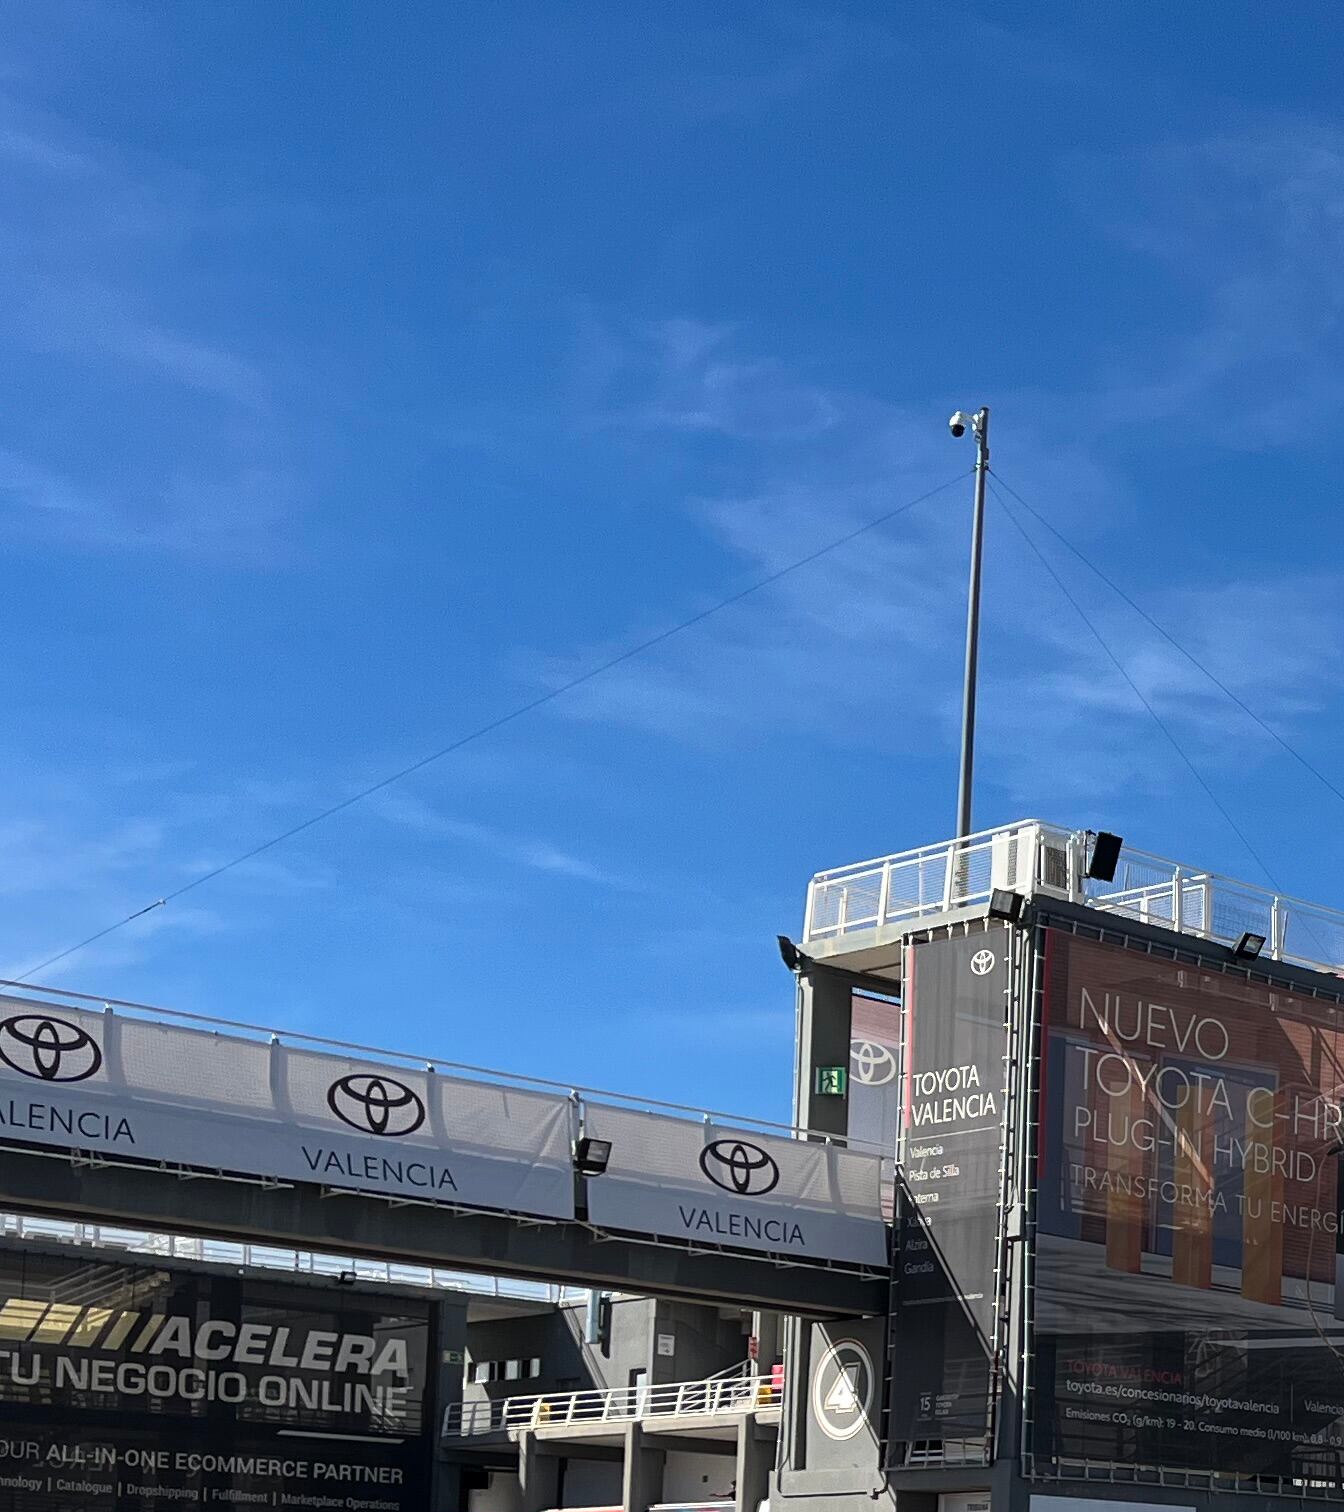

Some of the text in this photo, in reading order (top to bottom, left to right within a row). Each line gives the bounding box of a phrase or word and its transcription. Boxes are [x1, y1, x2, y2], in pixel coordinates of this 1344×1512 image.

[1080, 987, 1229, 1060] NUEVO
[912, 1064, 980, 1097] TOYOTA
[1075, 1046, 1344, 1145] TOYOTA C-HR
[911, 1092, 996, 1126] VALENCIA
[909, 1144, 943, 1159] Valencia
[1075, 1106, 1316, 1182] PLUG-IN HYBRID
[301, 1145, 458, 1191] VALENCIA
[909, 1168, 928, 1182] Pista
[930, 1167, 941, 1179] de
[1071, 1163, 1228, 1214] TRANSFORMA
[1235, 1194, 1262, 1219] TU
[678, 1205, 805, 1246] VALENCIA
[906, 1239, 928, 1251] Alzira
[149, 1315, 408, 1377] ACELERA
[55, 1356, 247, 1402] NEGOCIO
[258, 1375, 407, 1418] ONLINE
[1067, 1360, 1183, 1384] TOYOTA VALENCIA
[1066, 1379, 1280, 1415] toyota.es/concesionarios/toyotavalencia
[1304, 1400, 1344, 1415] Valencia
[1066, 1408, 1111, 1423] Emisiones
[1166, 1419, 1175, 1429] 19
[1198, 1422, 1238, 1436] Consumo
[46, 1443, 169, 1469] ALL-IN-ONE
[175, 1452, 308, 1478] ECOMMERCE
[313, 1463, 403, 1485] PARTNER
[56, 1479, 113, 1495] Catalogue
[126, 1483, 199, 1501] Dropshipping
[281, 1493, 343, 1509] Marketplace
[345, 1497, 400, 1511] Operations
